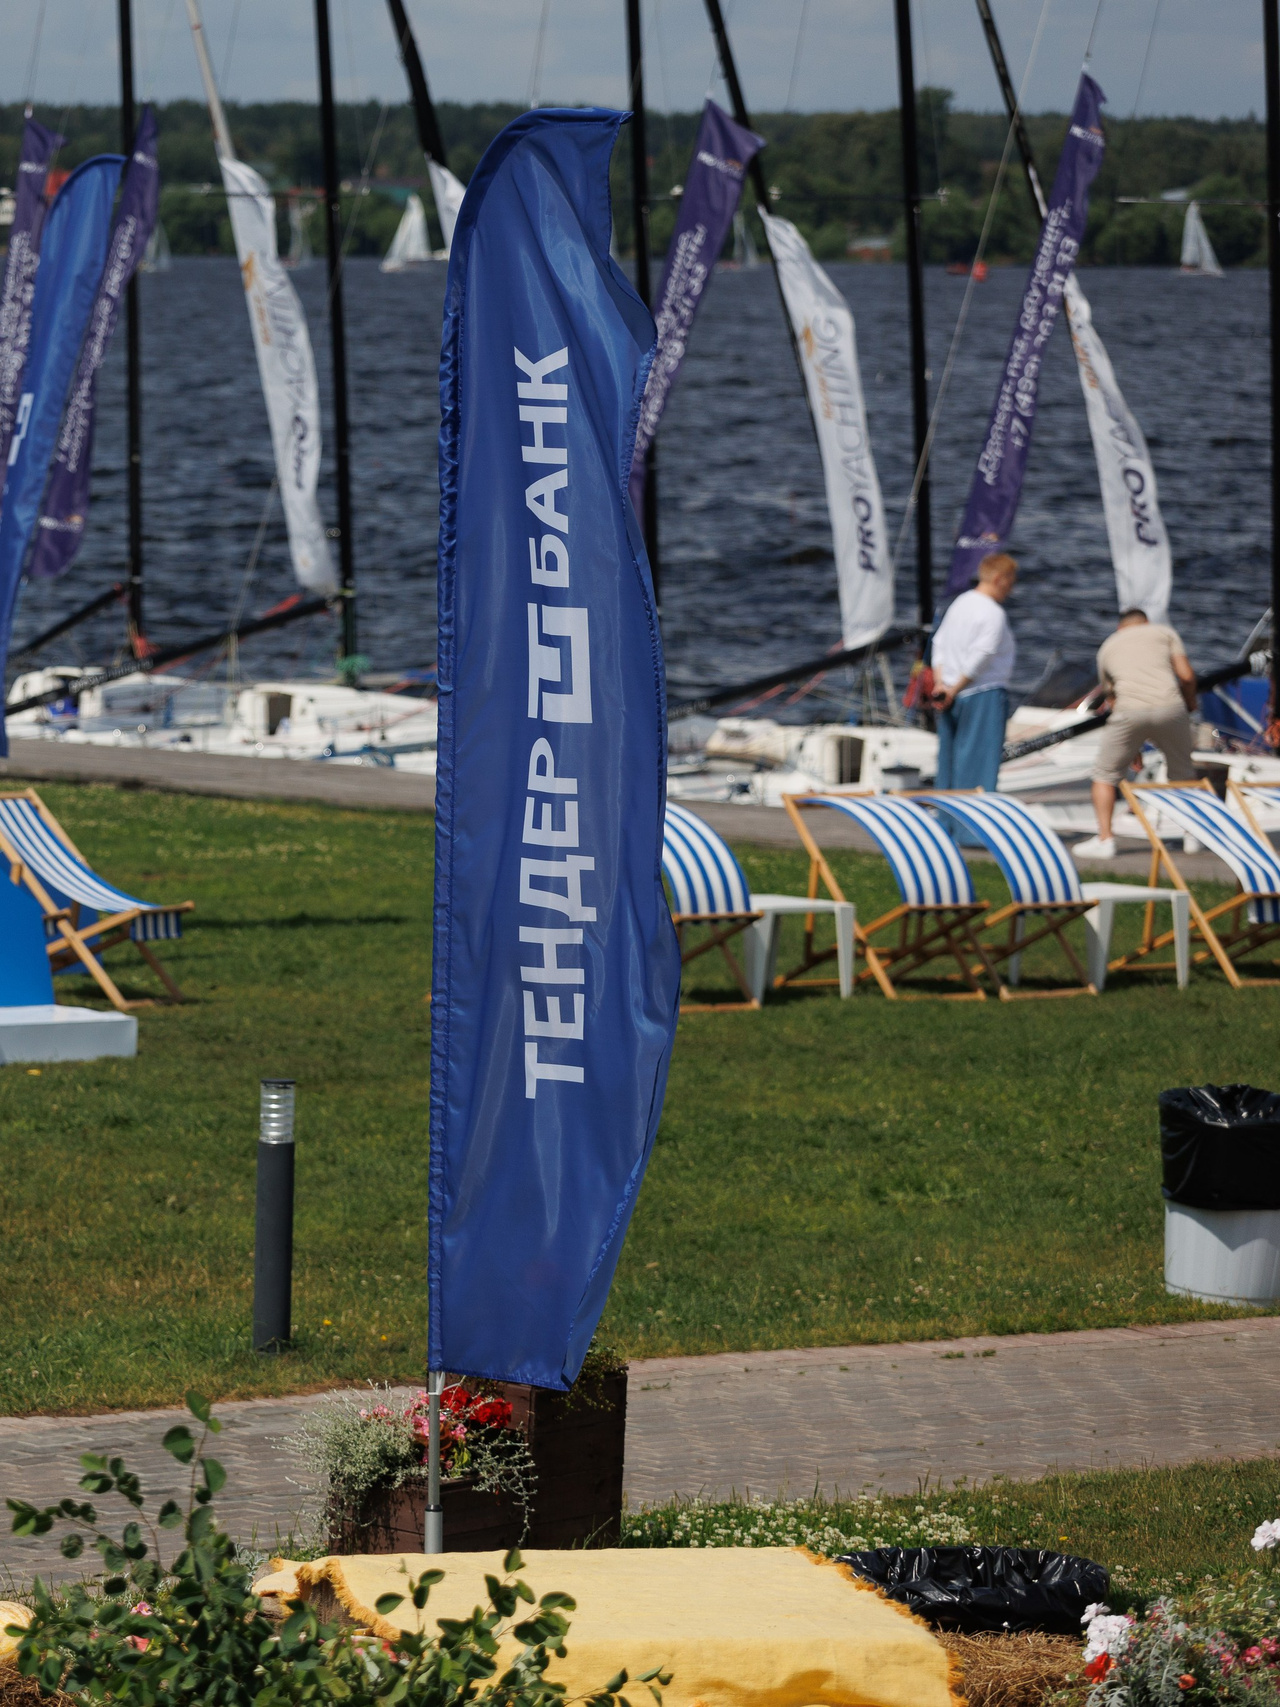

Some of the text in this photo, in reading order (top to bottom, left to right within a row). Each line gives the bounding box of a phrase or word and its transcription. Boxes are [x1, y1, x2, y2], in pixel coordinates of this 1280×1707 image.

[514, 346, 569, 588] БАНК
[812, 314, 877, 573] PROYACHTING
[519, 737, 597, 1099] ТЕНДЕР
